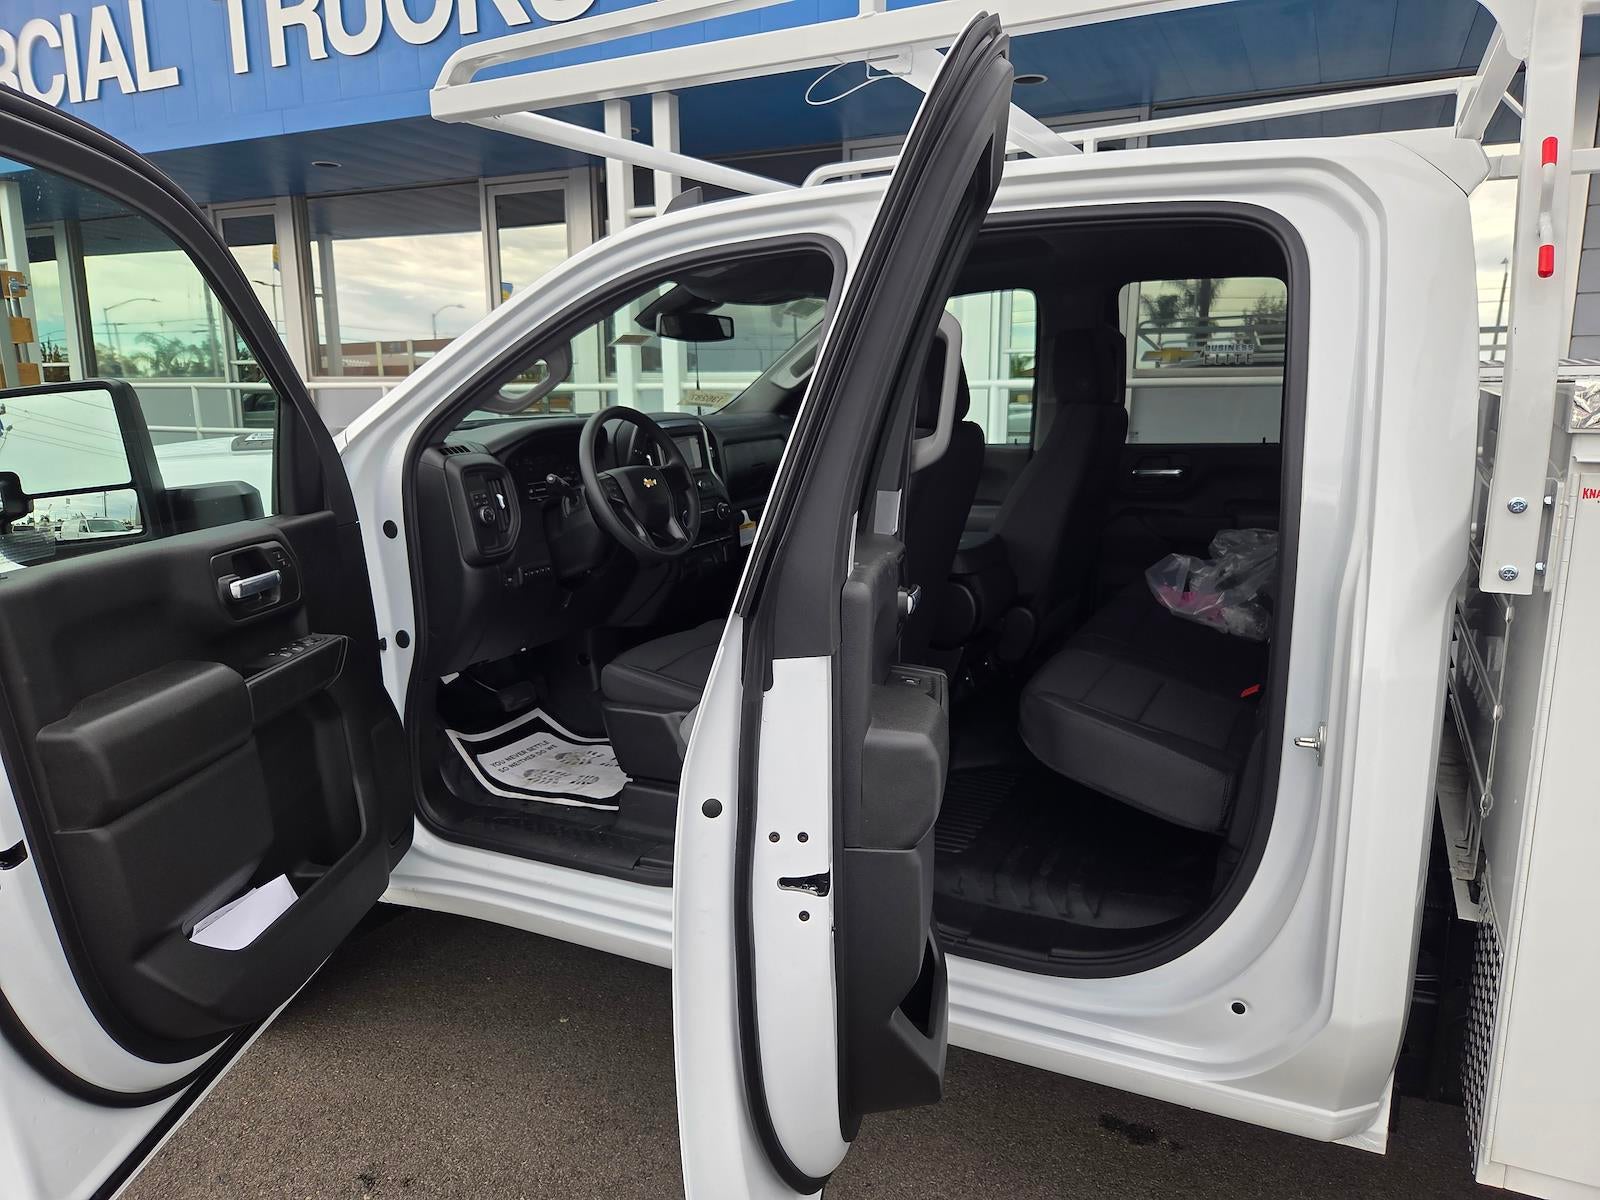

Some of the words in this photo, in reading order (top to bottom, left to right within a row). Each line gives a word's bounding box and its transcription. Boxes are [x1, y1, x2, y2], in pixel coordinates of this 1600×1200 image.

[222, 0, 596, 75] TRU
[1204, 344, 1254, 353] BUSINESS
[1204, 353, 1252, 365] ELITE
[490, 759, 506, 768] YOU
[504, 750, 527, 761] NEVER
[526, 740, 550, 752] SETTLE
[508, 753, 536, 768] NEITHER
